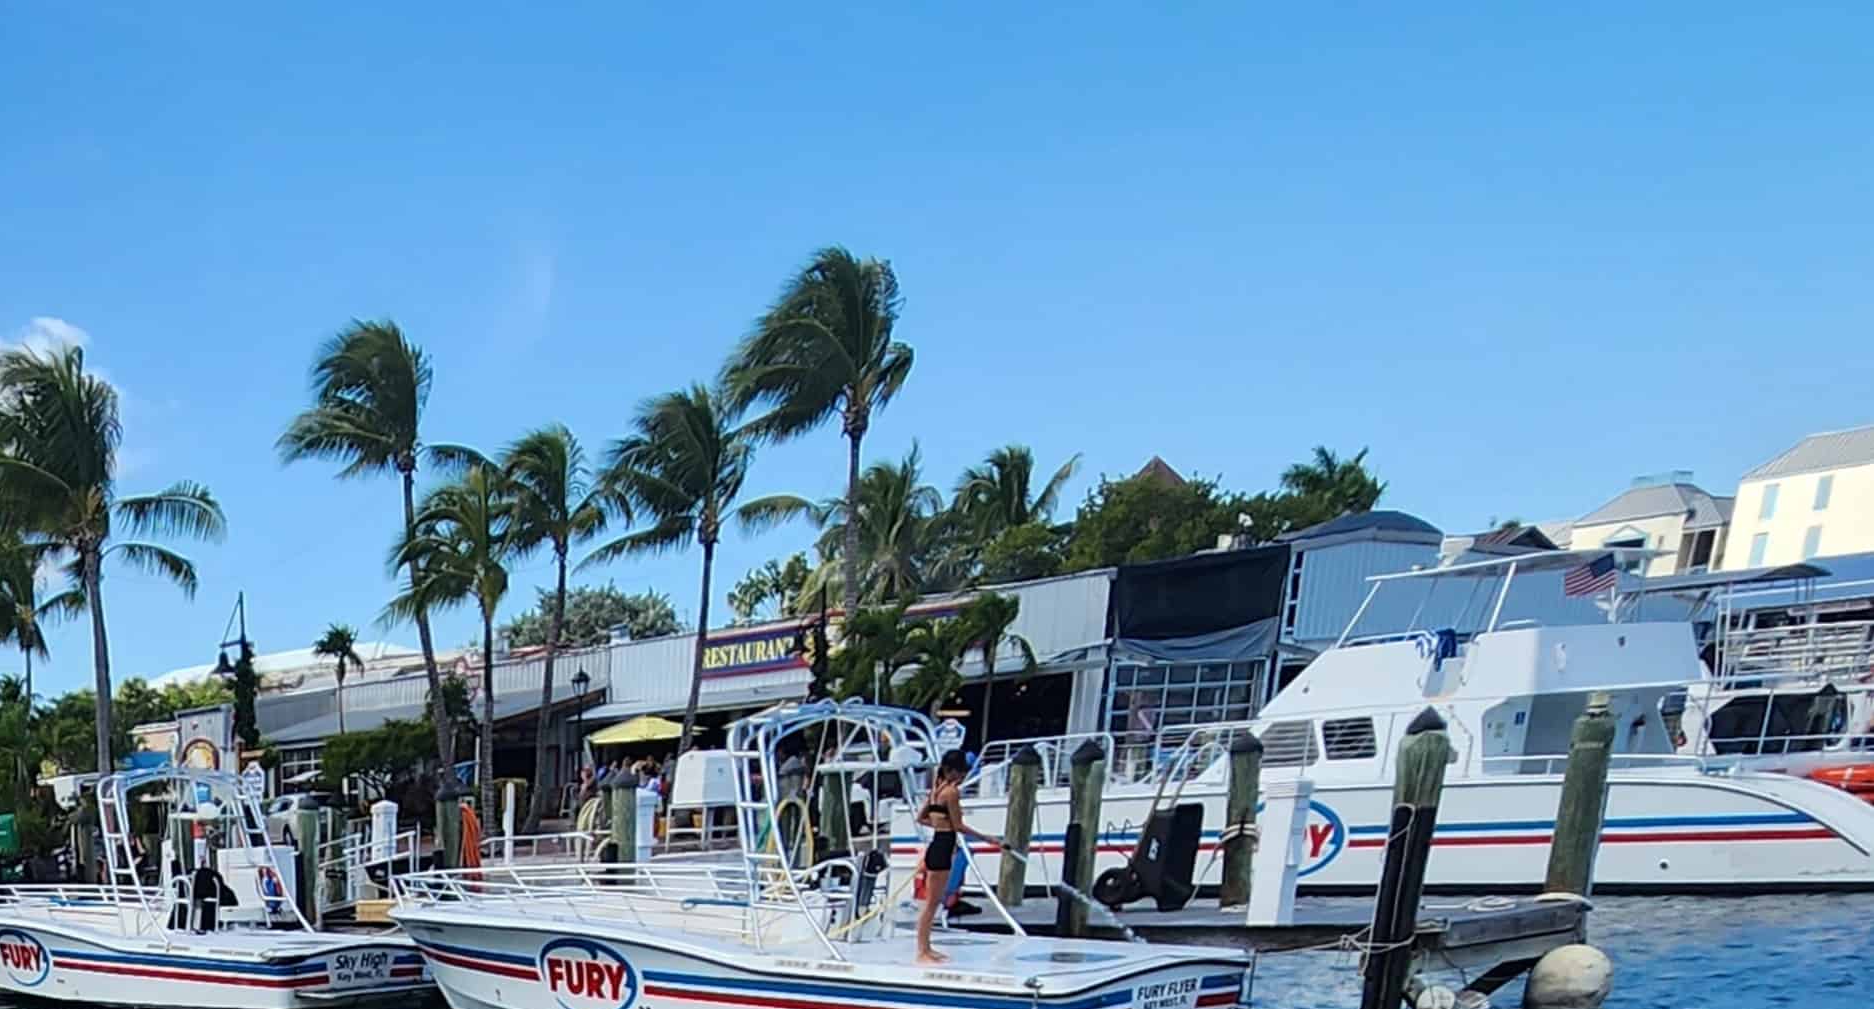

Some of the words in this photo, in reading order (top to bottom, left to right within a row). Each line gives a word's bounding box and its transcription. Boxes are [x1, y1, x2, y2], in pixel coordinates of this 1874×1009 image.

[0, 943, 41, 972] FURY
[334, 954, 358, 971] Sky
[360, 952, 388, 969] High
[547, 958, 626, 1001] FURY
[1137, 984, 1167, 1001] FURY
